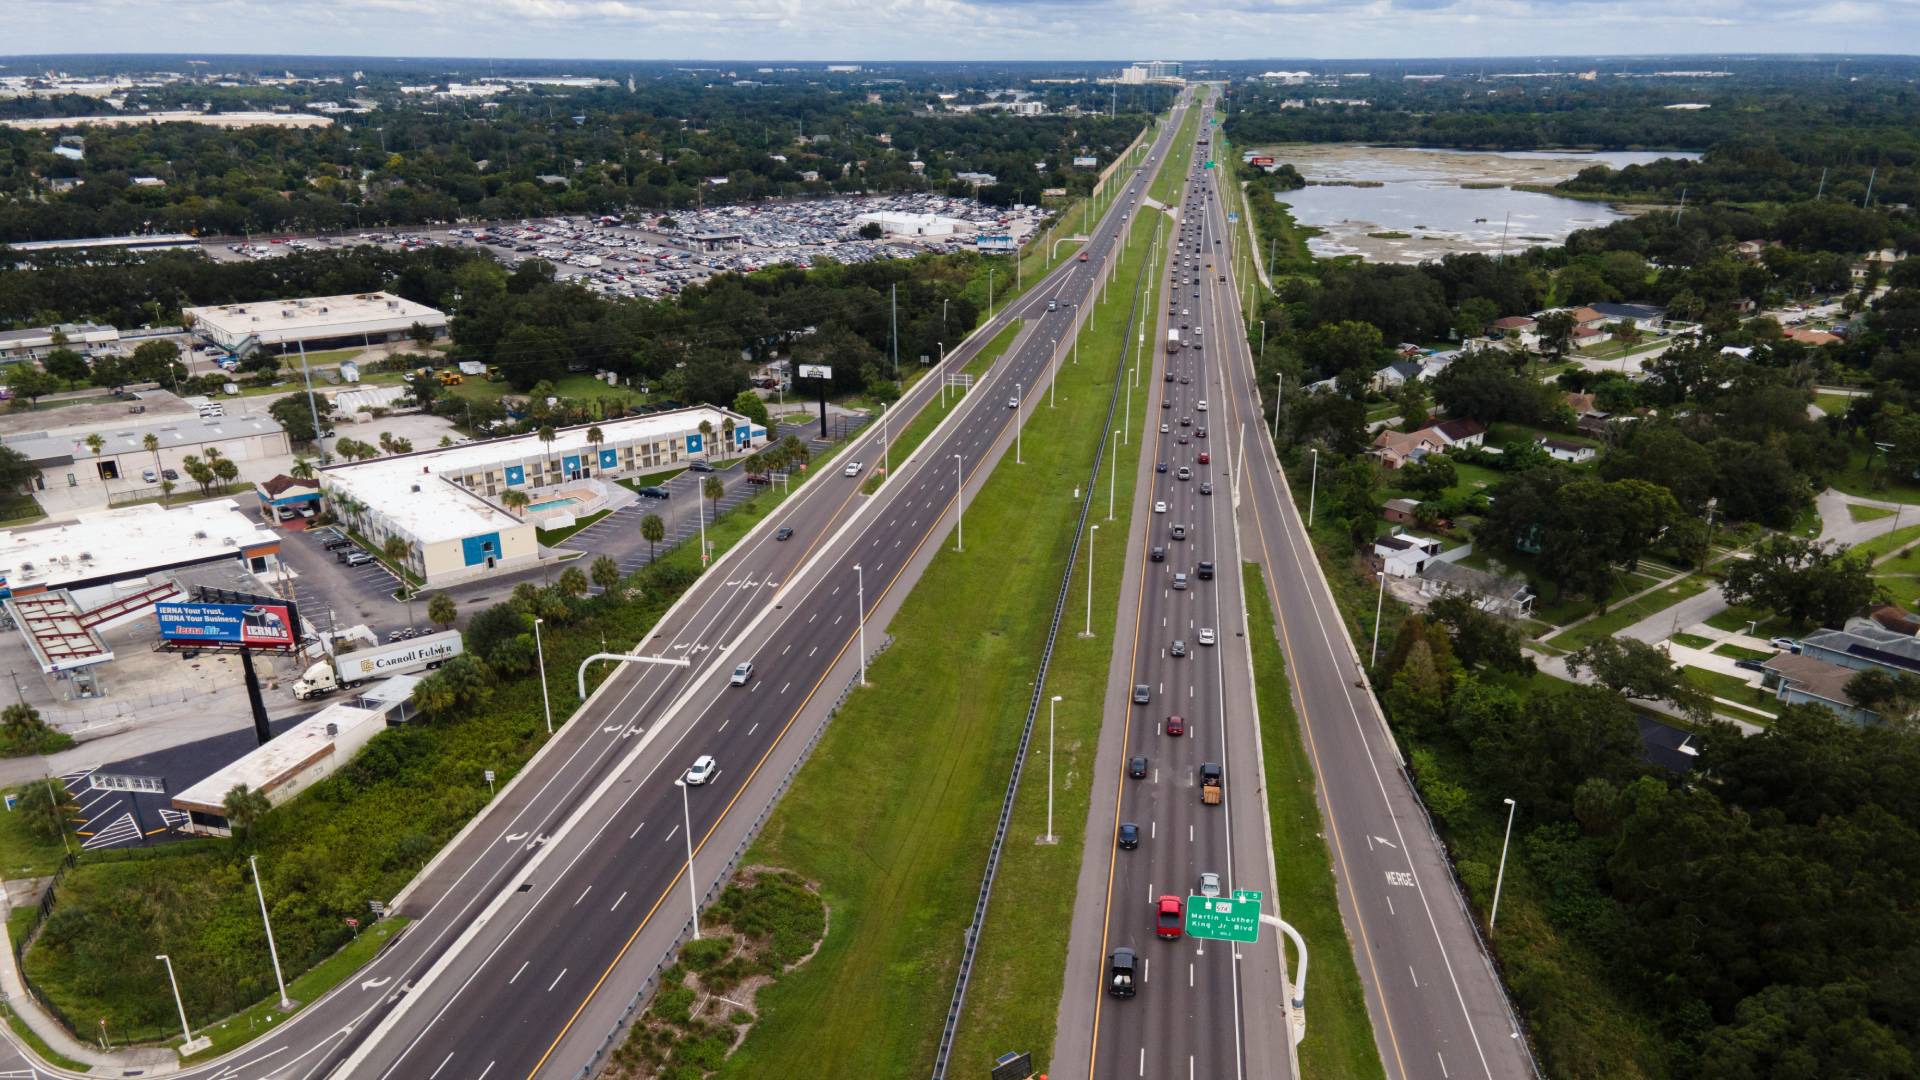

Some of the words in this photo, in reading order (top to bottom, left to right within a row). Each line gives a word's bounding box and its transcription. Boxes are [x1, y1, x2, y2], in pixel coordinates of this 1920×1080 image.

[183, 607, 200, 615] Your
[202, 607, 224, 616] Trust,
[161, 614, 185, 622] IERNA
[204, 615, 239, 623] Business.
[1385, 871, 1414, 887] MERGE
[1191, 913, 1219, 921] Martin
[1225, 916, 1254, 924] Luther
[1191, 921, 1211, 929] King
[1234, 924, 1253, 932] Blvd
